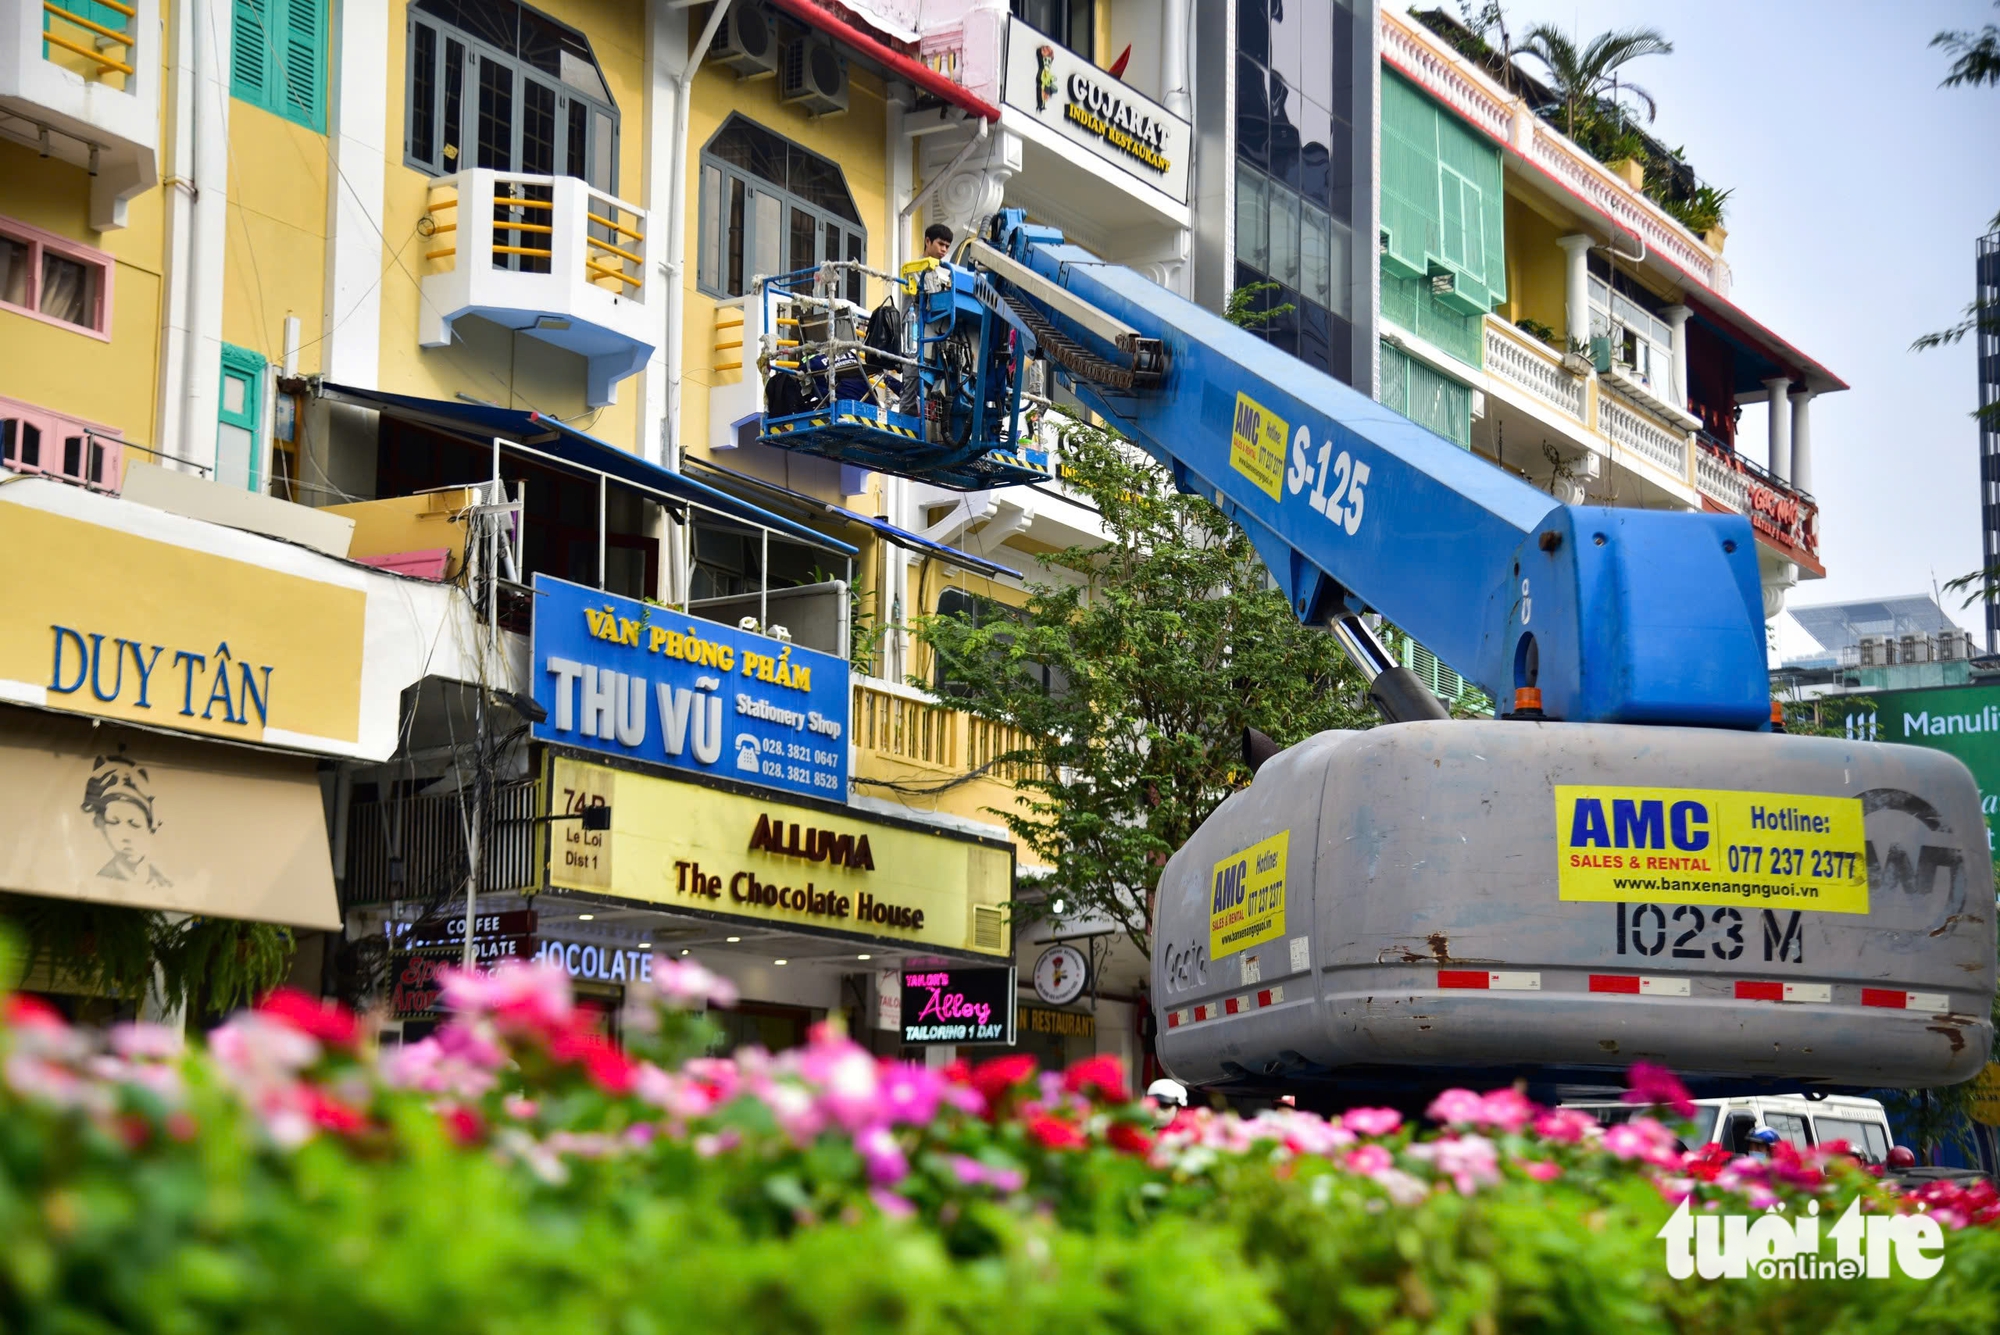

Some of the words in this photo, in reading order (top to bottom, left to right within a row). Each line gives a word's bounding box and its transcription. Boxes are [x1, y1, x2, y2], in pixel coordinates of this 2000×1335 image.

[1067, 73, 1170, 151] GUJARAT
[1067, 103, 1106, 136] INDIAN
[1107, 127, 1171, 173] RESTAURANT
[1235, 401, 1260, 446] AMC
[1287, 424, 1371, 536] S-125
[584, 605, 641, 647] VĂN
[648, 626, 735, 672] PHÒNG
[741, 646, 811, 692] PHẨM
[47, 624, 165, 708] DUY
[172, 641, 274, 728] TÂN
[546, 656, 647, 747] THU
[656, 676, 723, 764] VŨ
[736, 693, 805, 731] Stationery
[808, 711, 841, 740] Shop
[762, 738, 785, 756] 028.
[787, 743, 811, 762] 3821
[814, 750, 838, 768] 0647
[762, 760, 784, 779] 028.
[787, 765, 811, 784] 3821
[813, 772, 838, 790] 8528
[566, 827, 580, 844] Le
[584, 830, 602, 847] Loi
[1570, 798, 1710, 852] AMC
[1751, 805, 1830, 833] Hotline:
[565, 850, 588, 868] Dist
[591, 855, 598, 870] 1
[748, 813, 876, 871] ALLUVIA
[1728, 844, 1763, 873] 077
[1769, 847, 1804, 876] 237
[1811, 850, 1856, 879] 2377
[1570, 854, 1623, 869] SALES
[1627, 856, 1641, 869] &
[1649, 857, 1711, 872] RENTAL
[675, 860, 722, 898] The
[730, 870, 850, 918] Chocolate
[857, 891, 925, 929] House
[1213, 860, 1247, 915] AMC
[1247, 890, 1258, 917] 077
[1613, 877, 1819, 898] www.banxenangnguoi.vn
[447, 916, 500, 935] COFEE
[1212, 918, 1225, 932] SALES
[1616, 902, 1744, 961] 1023
[1762, 908, 1803, 963] M
[918, 986, 991, 1025] Alley
[1031, 1009, 1095, 1038] RESTAURANT
[905, 1025, 967, 1041] TAILORING
[967, 1025, 975, 1039] 1
[977, 1024, 1003, 1039] DAY
